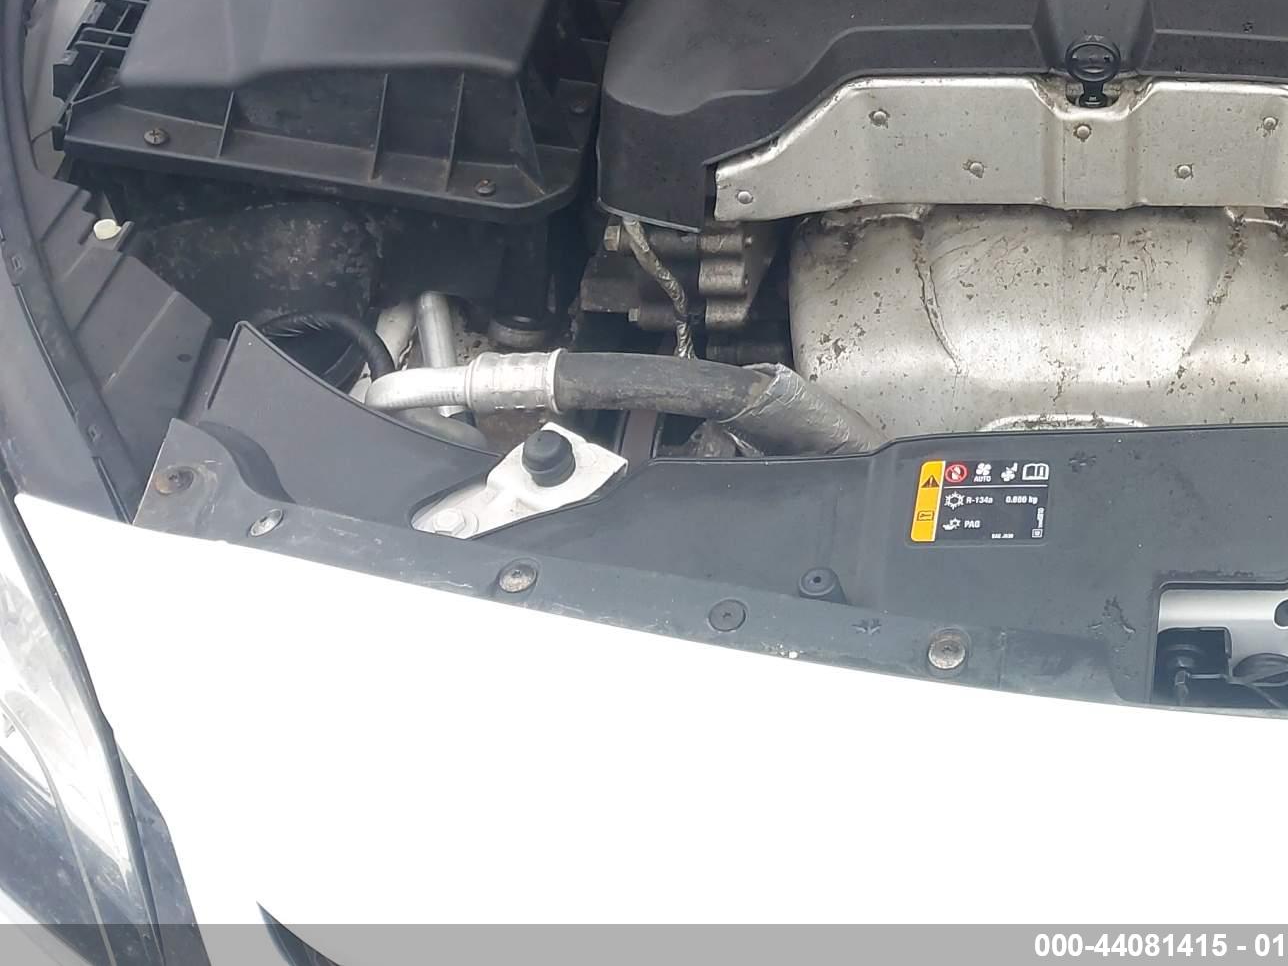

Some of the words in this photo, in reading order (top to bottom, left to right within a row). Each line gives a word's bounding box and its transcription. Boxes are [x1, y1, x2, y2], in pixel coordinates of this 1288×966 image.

[973, 475, 991, 483] AUTO
[1028, 496, 1038, 505] kg
[964, 520, 980, 528] PAG
